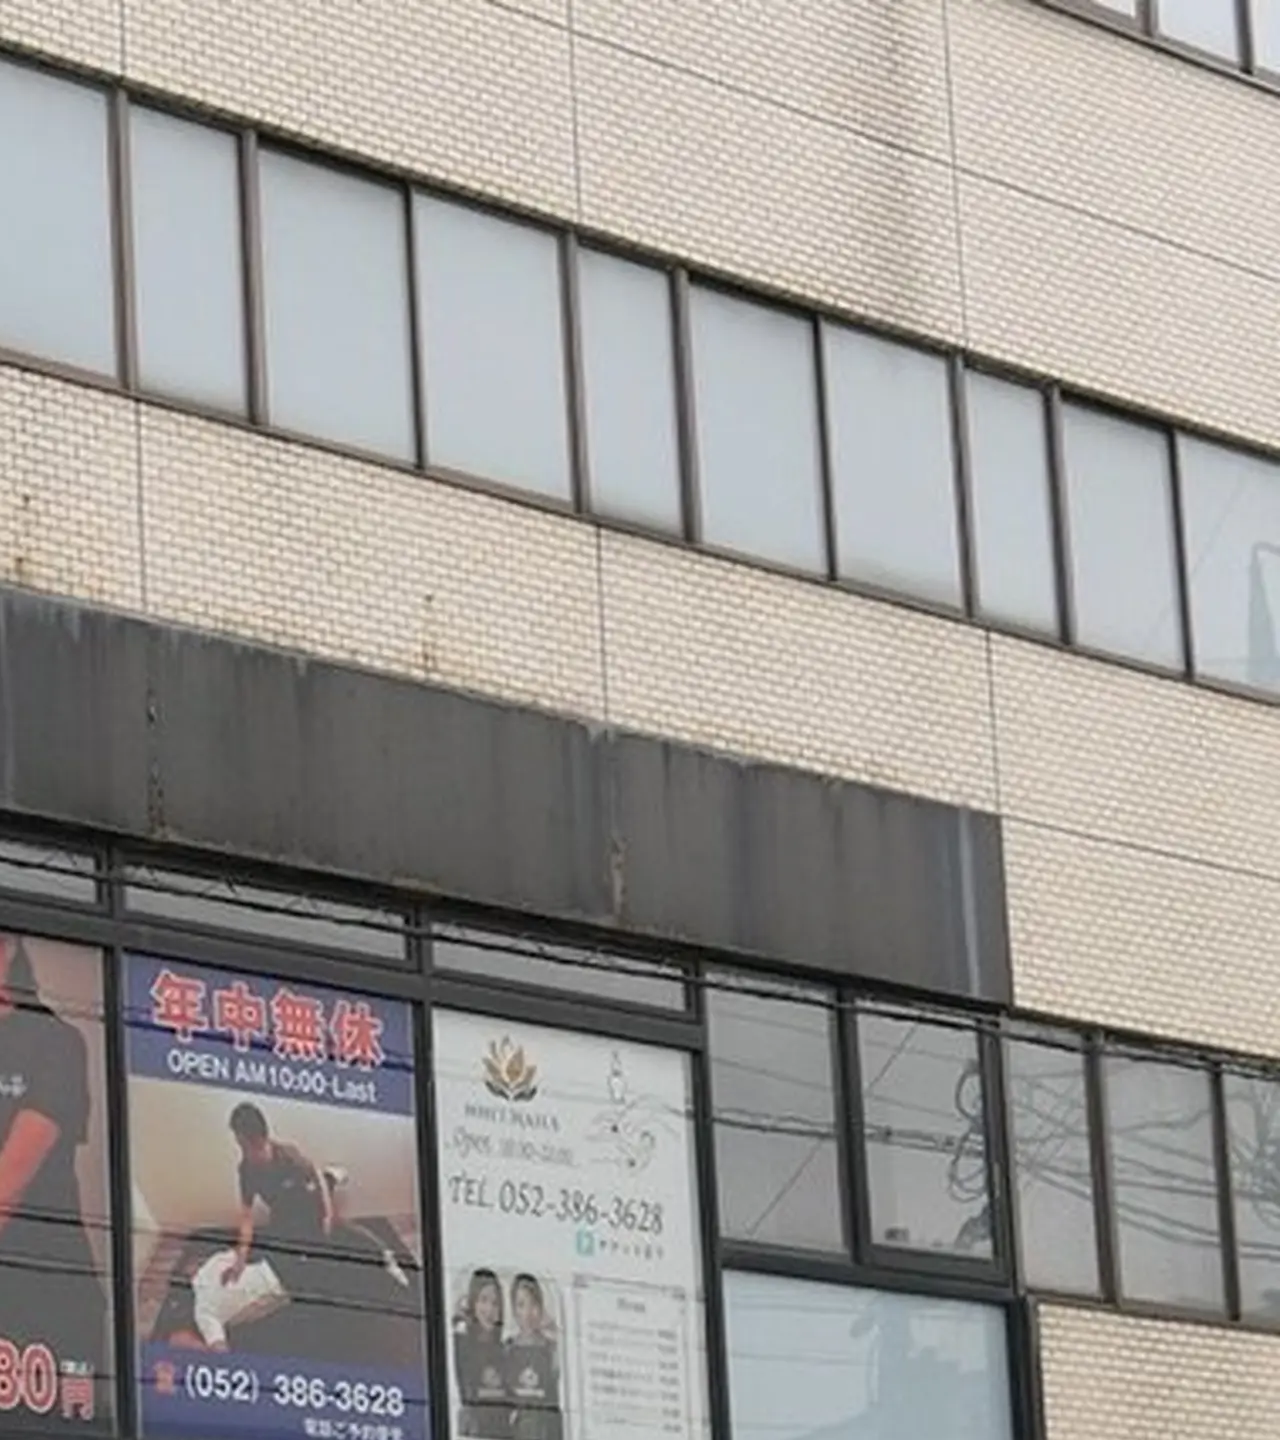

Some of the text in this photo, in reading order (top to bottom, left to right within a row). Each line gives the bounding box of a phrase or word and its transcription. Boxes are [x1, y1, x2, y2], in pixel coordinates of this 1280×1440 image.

[151, 971, 386, 1071] 年中無休
[168, 1049, 229, 1080] OPEN
